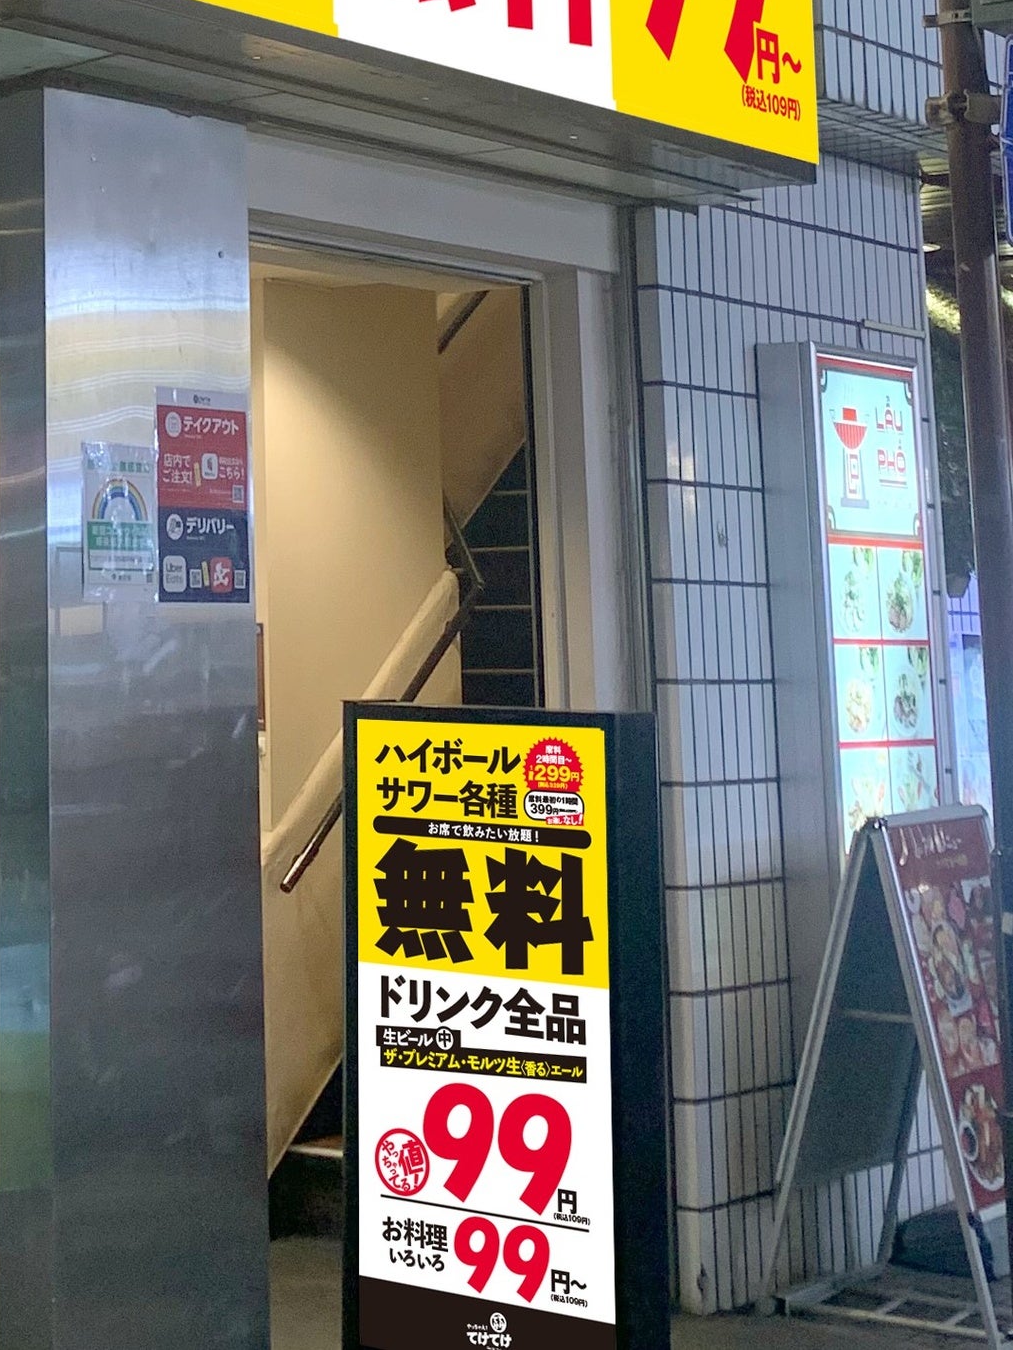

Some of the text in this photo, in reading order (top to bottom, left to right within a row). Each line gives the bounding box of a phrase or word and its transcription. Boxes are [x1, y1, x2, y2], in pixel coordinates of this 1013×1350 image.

[183, 416, 239, 435] テイクアウト
[186, 516, 235, 535] デリバリー
[374, 737, 522, 775] ハイボール
[376, 777, 519, 819] サワー各種
[428, 822, 539, 843] お席で飲みたい放題!
[373, 837, 594, 976] 無料
[381, 974, 587, 1045] ドリンク全品
[382, 1216, 448, 1253] お料理
[389, 1248, 445, 1272] いろいろ
[466, 1331, 512, 1348] てけてけ
